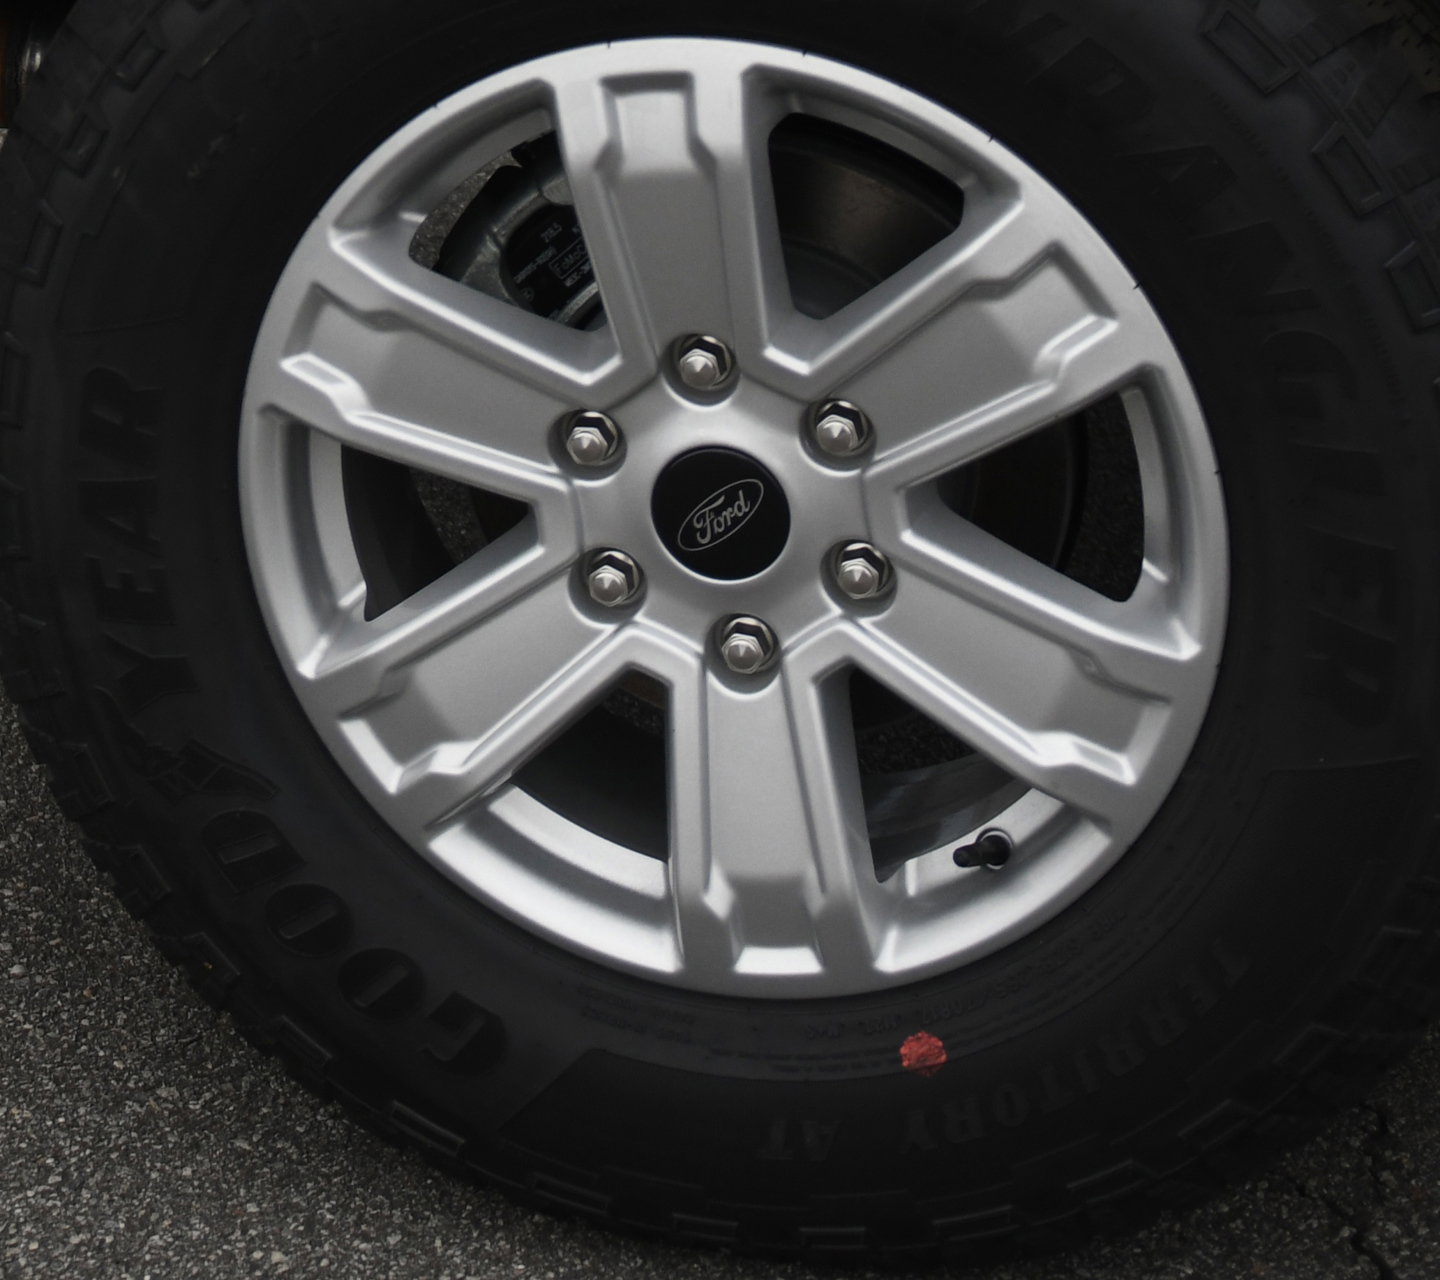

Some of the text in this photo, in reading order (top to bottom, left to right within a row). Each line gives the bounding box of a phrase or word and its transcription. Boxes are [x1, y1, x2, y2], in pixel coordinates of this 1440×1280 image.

[692, 489, 751, 544] Ford
[77, 365, 509, 1077] GOODYEAR
[754, 938, 1253, 1162] TERRITORY AT
